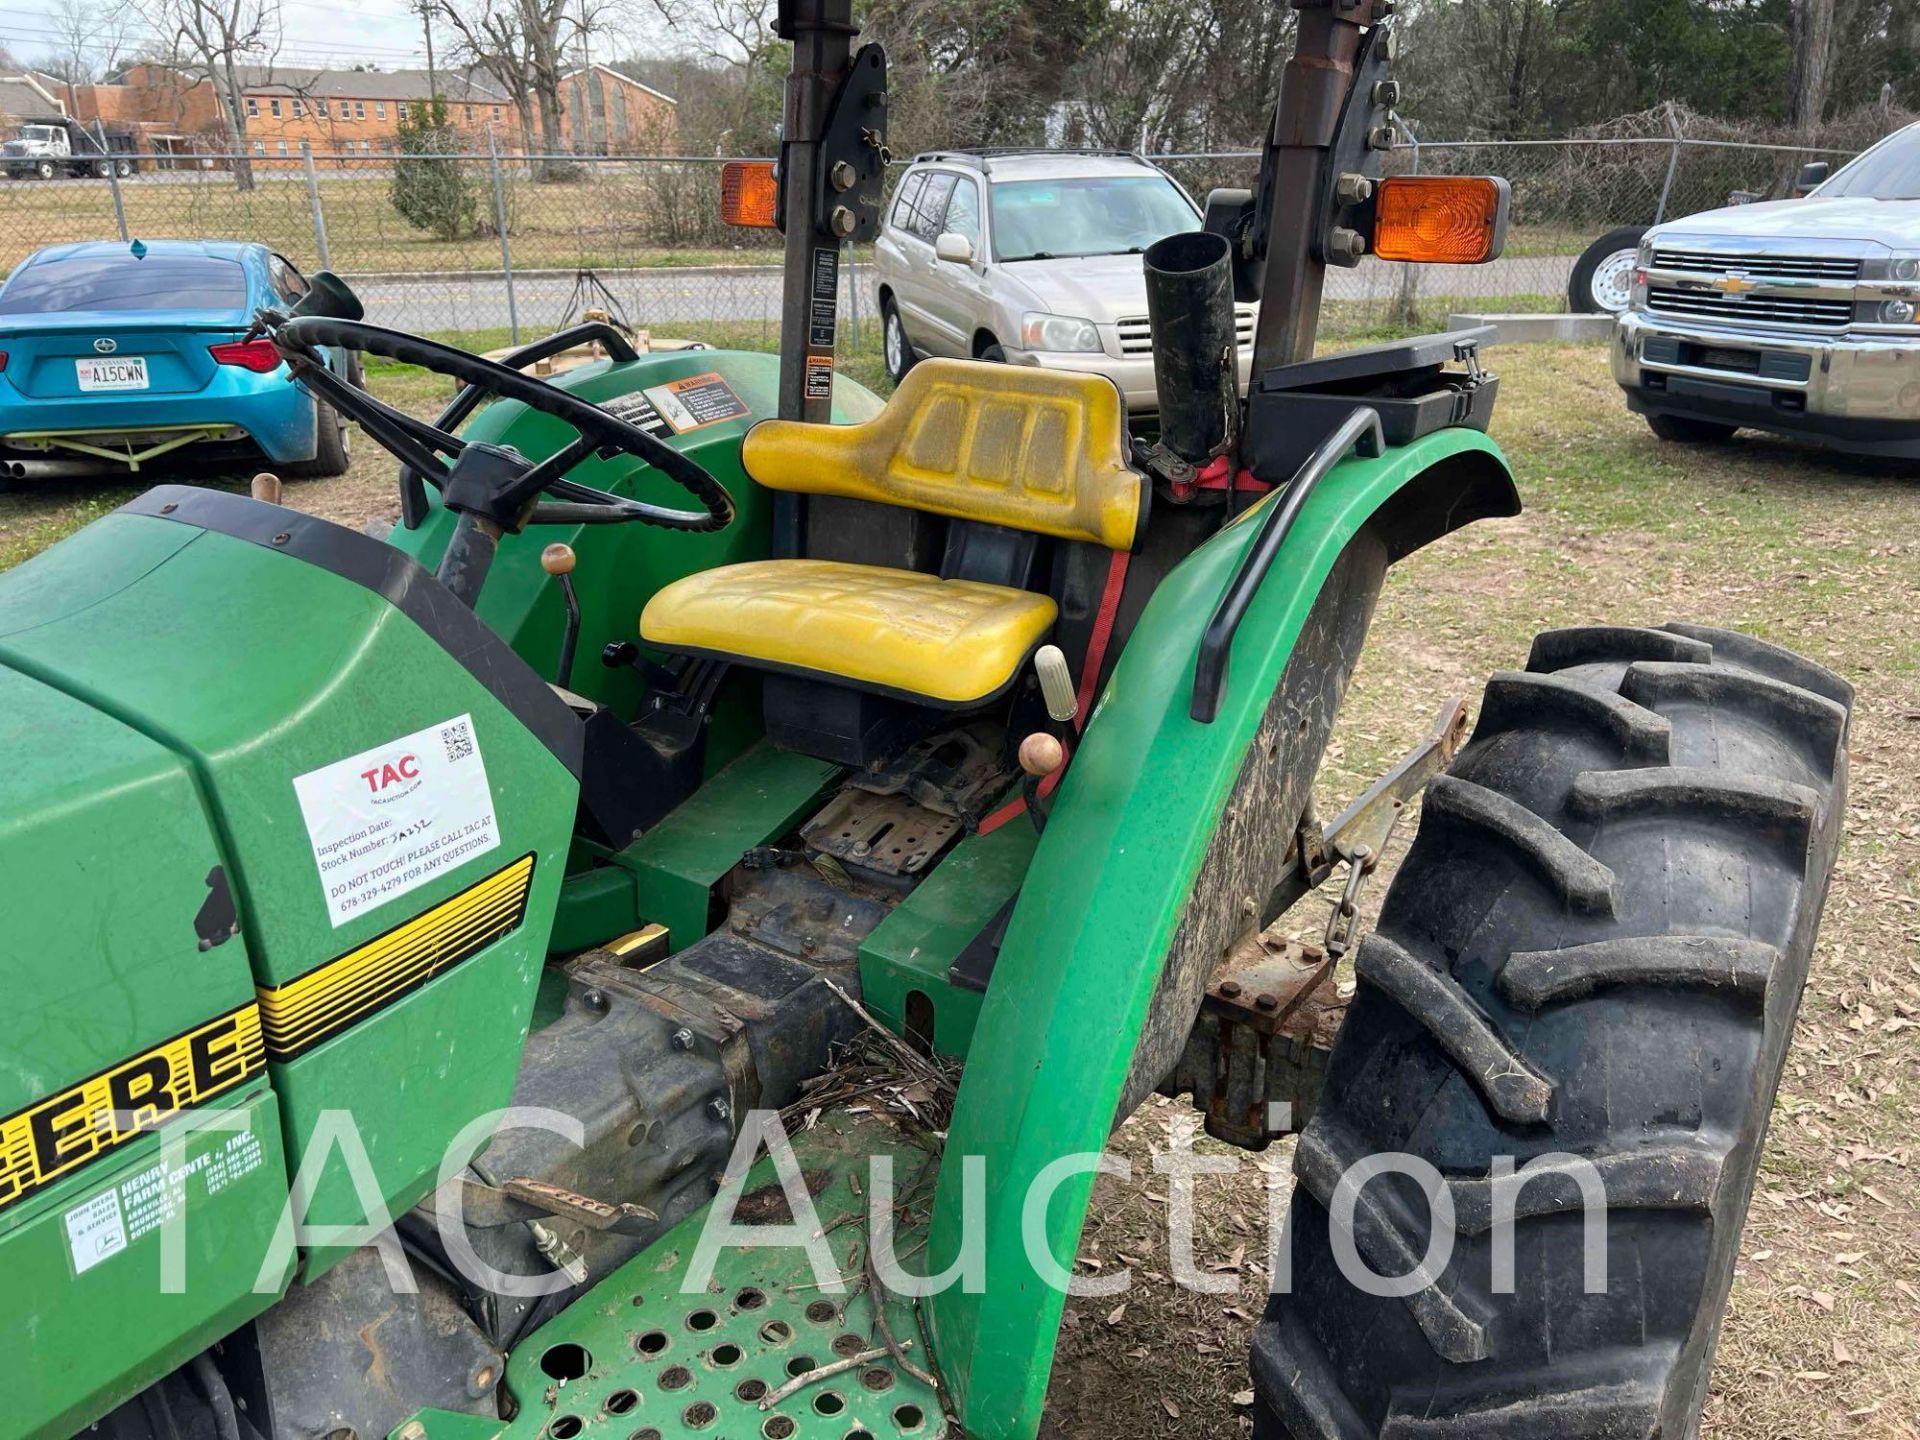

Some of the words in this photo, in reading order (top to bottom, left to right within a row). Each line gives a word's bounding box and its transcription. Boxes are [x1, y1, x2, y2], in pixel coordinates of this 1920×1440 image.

[93, 366, 144, 383] A15CWN
[360, 755, 419, 792] TAC
[317, 830, 367, 856] Inspection
[368, 819, 392, 834] Date:
[320, 854, 347, 871] Stock
[348, 837, 389, 859] Number:
[331, 883, 346, 898] DO
[348, 873, 368, 890] NOT
[369, 855, 405, 879] TOUCH!
[407, 839, 440, 862] PLEASE
[441, 829, 463, 845] CALL
[463, 820, 480, 834] TAC
[481, 815, 490, 827] AT
[340, 876, 401, 911] 678-329-4279
[402, 866, 421, 882] FOR
[423, 856, 440, 872] ANY
[442, 833, 490, 862] QUESTIONS.
[0, 1017, 246, 1202] ERE
[121, 1160, 170, 1196] HENRY
[122, 1176, 166, 1210] FARM
[226, 1129, 254, 1152] INC.
